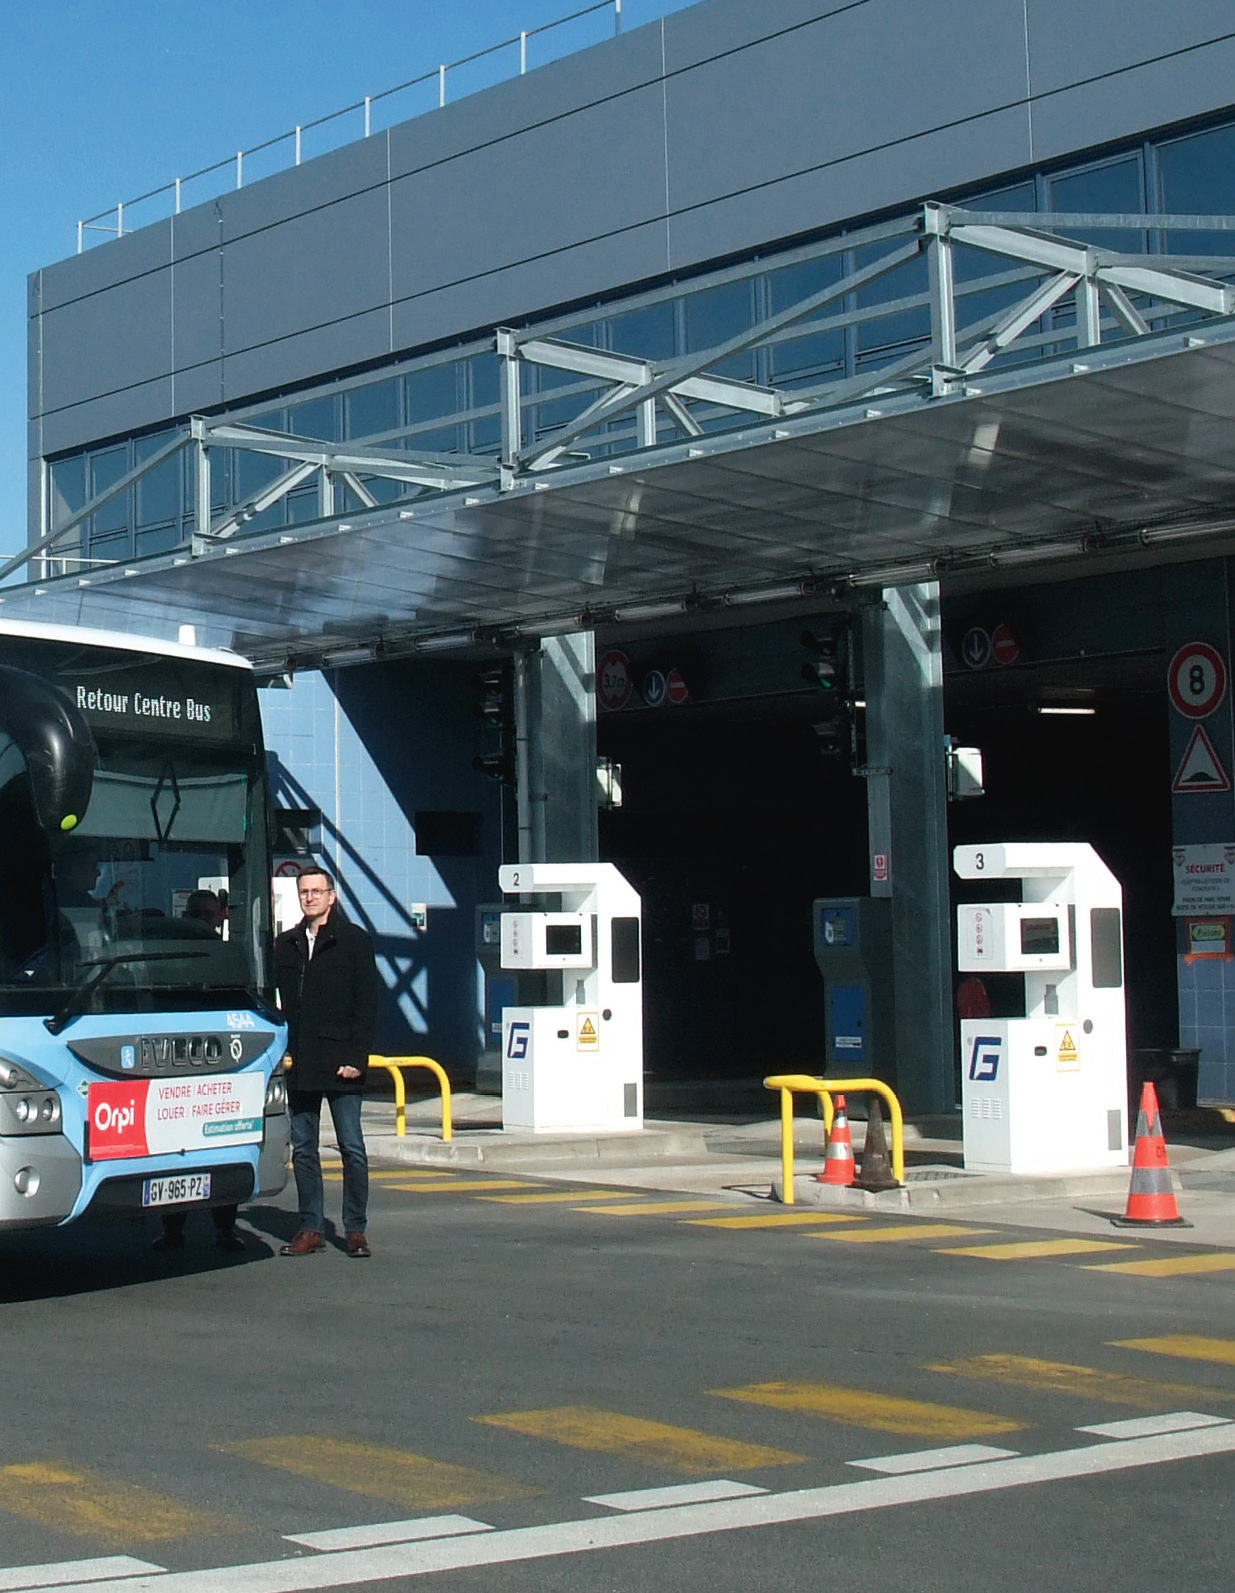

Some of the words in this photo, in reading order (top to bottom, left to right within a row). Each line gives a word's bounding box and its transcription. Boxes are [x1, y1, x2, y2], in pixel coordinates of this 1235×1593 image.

[1189, 664, 1205, 695] 8
[76, 685, 129, 713] Retour
[134, 692, 181, 719] Centre
[186, 698, 211, 722] Bus
[975, 853, 985, 870] 3
[512, 872, 520, 887] 2
[226, 1013, 255, 1029] 4544
[140, 1035, 223, 1068] IVECO
[158, 1085, 192, 1100] VENDRE
[197, 1081, 233, 1096] ACHETER
[94, 1099, 134, 1133] Orpi
[157, 1106, 185, 1121] LOUER
[191, 1103, 214, 1117] FAIRE
[215, 1098, 241, 1114] GÉRER
[150, 1176, 203, 1202] GV-965-PZ
